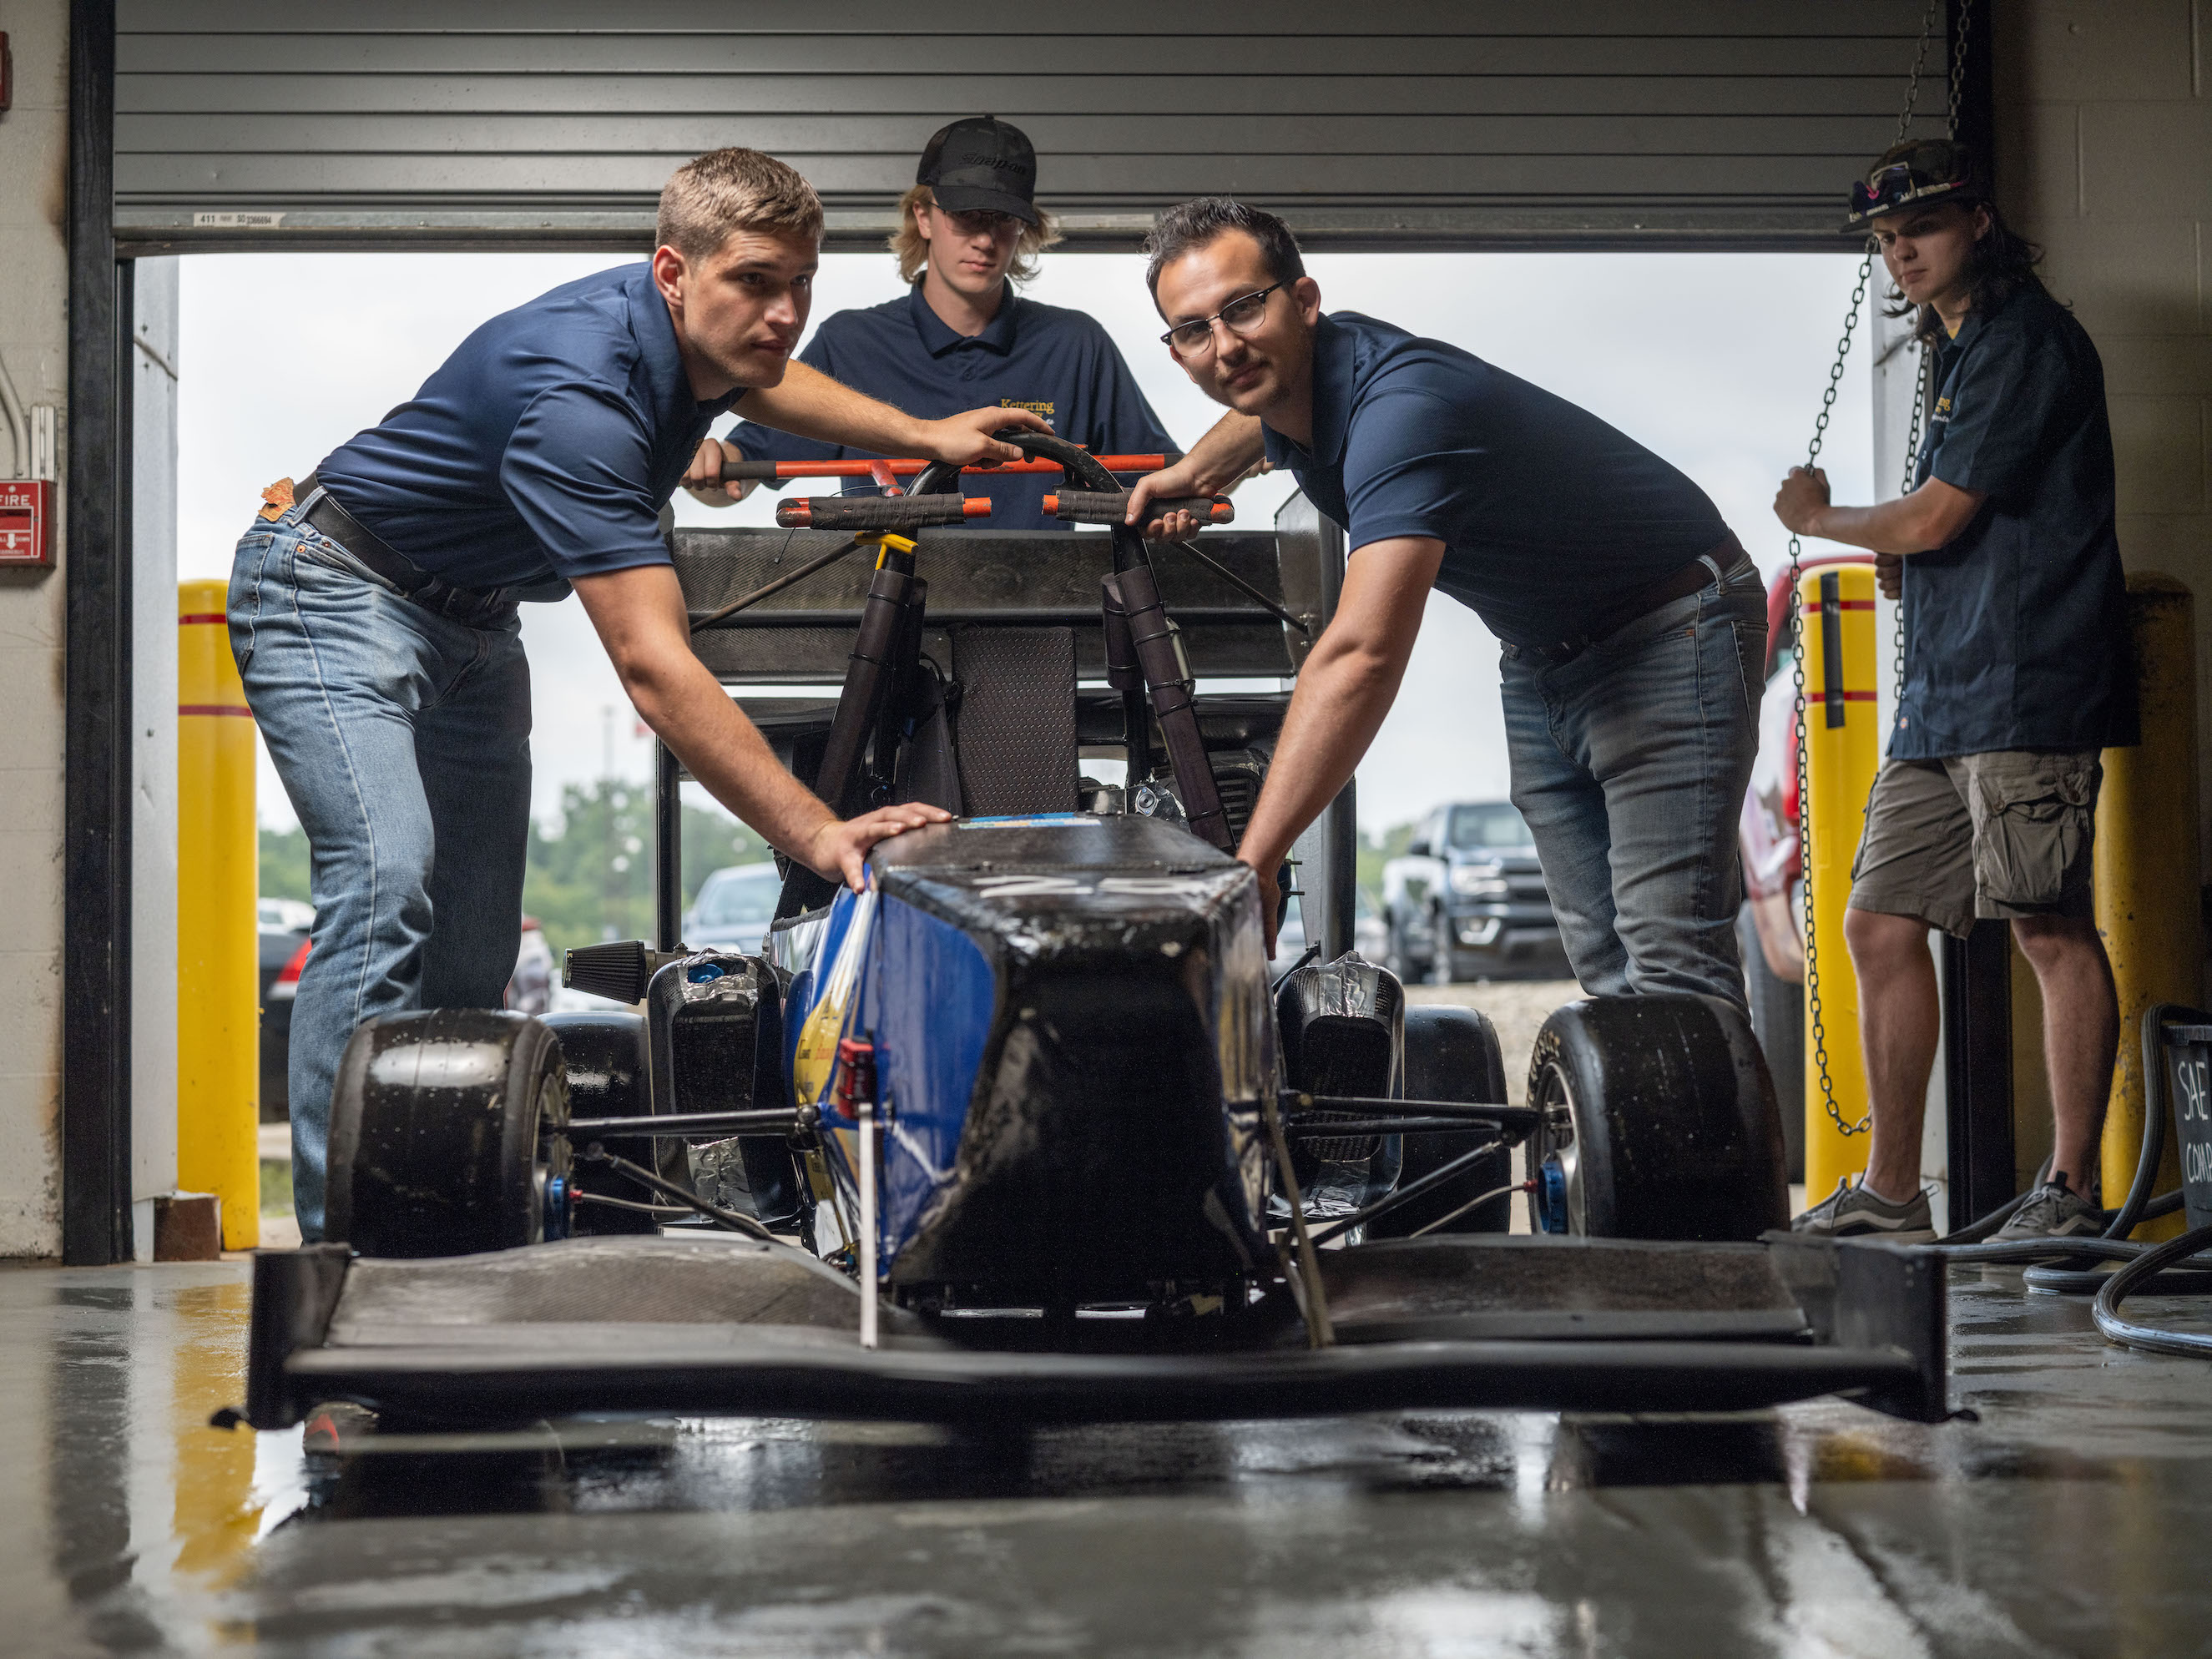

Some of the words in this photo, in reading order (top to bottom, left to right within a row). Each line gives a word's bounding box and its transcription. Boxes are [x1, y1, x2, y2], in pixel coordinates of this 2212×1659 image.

[200, 214, 215, 224] 411
[1001, 398, 1055, 415] Kettering
[2178, 1061, 2209, 1122] SAE
